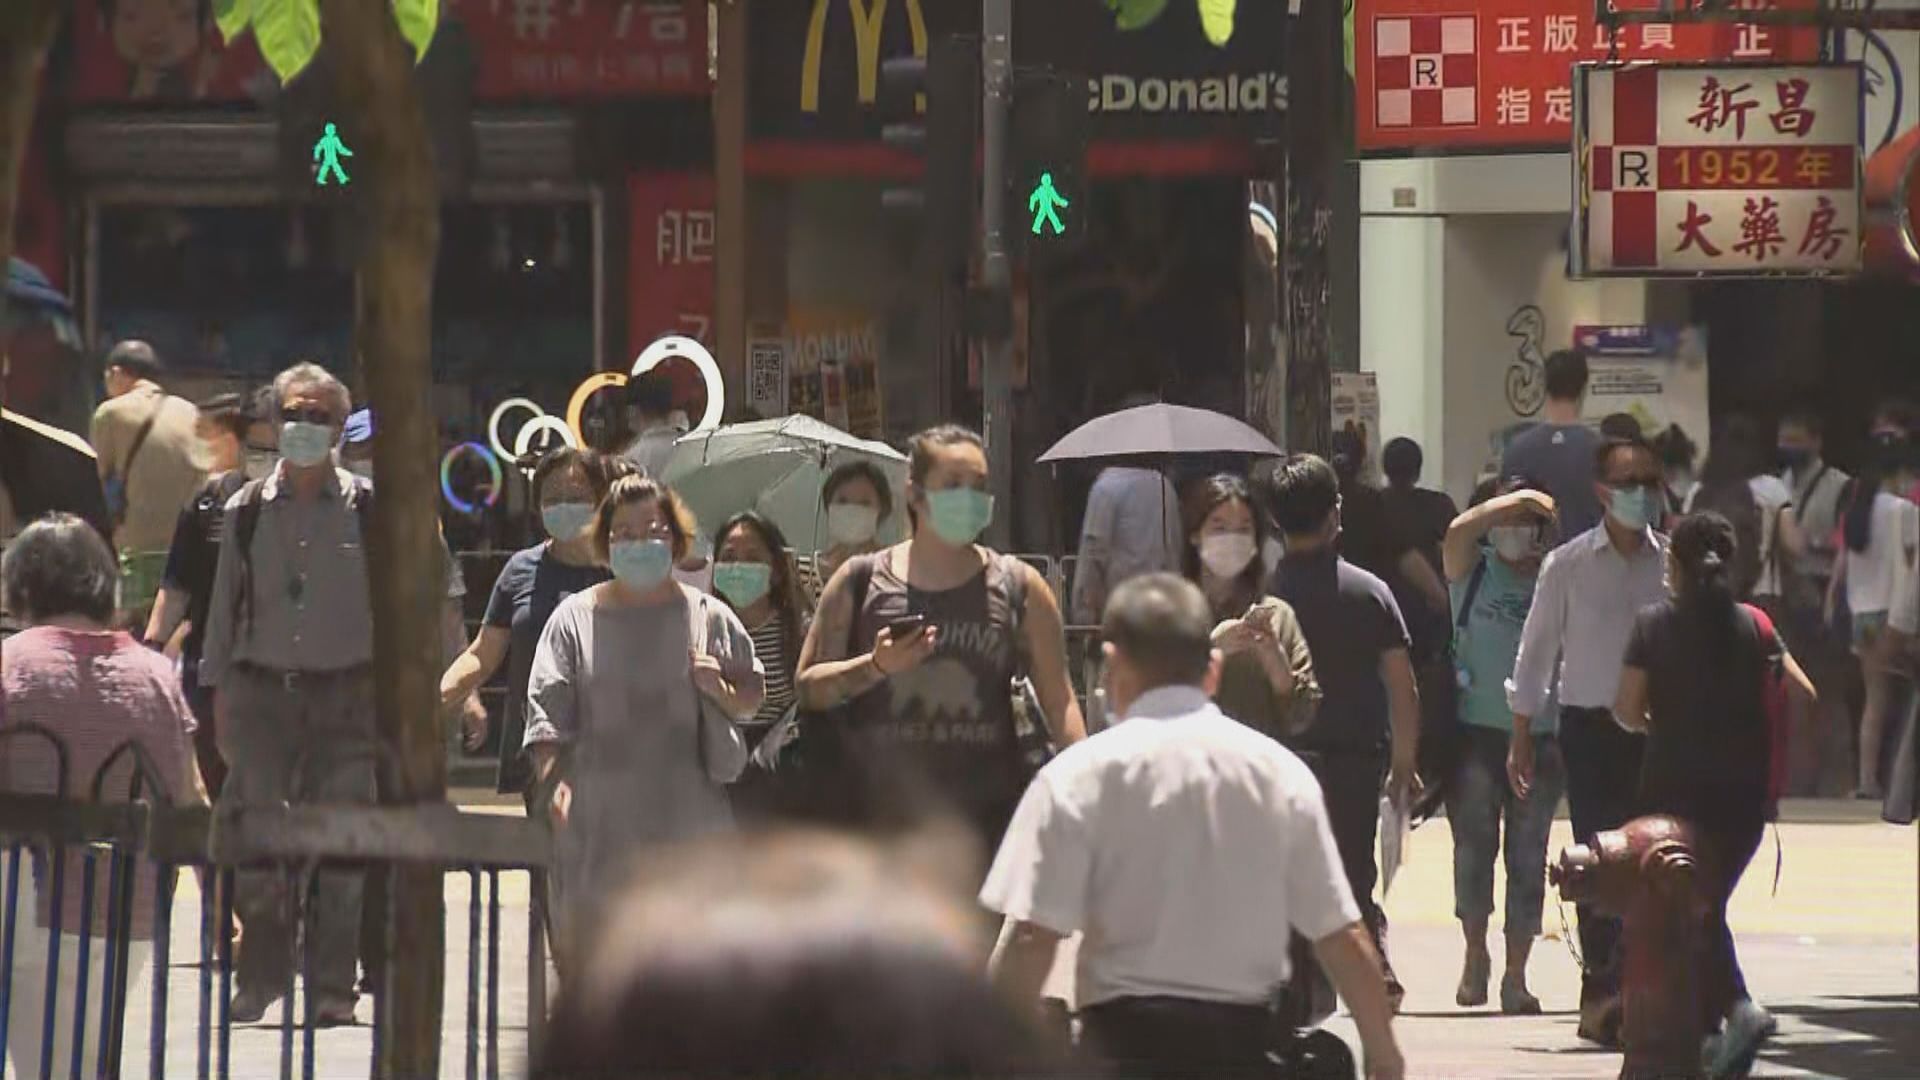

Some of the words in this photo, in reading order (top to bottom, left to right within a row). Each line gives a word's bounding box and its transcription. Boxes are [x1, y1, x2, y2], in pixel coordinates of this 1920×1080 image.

[1496, 86, 1572, 125] 指定
[1687, 75, 1816, 141] 新昌
[1674, 149, 1781, 185] 1952
[1795, 148, 1832, 185] 年
[1674, 196, 1849, 262] 大藥房
[1506, 304, 1546, 417] 3
